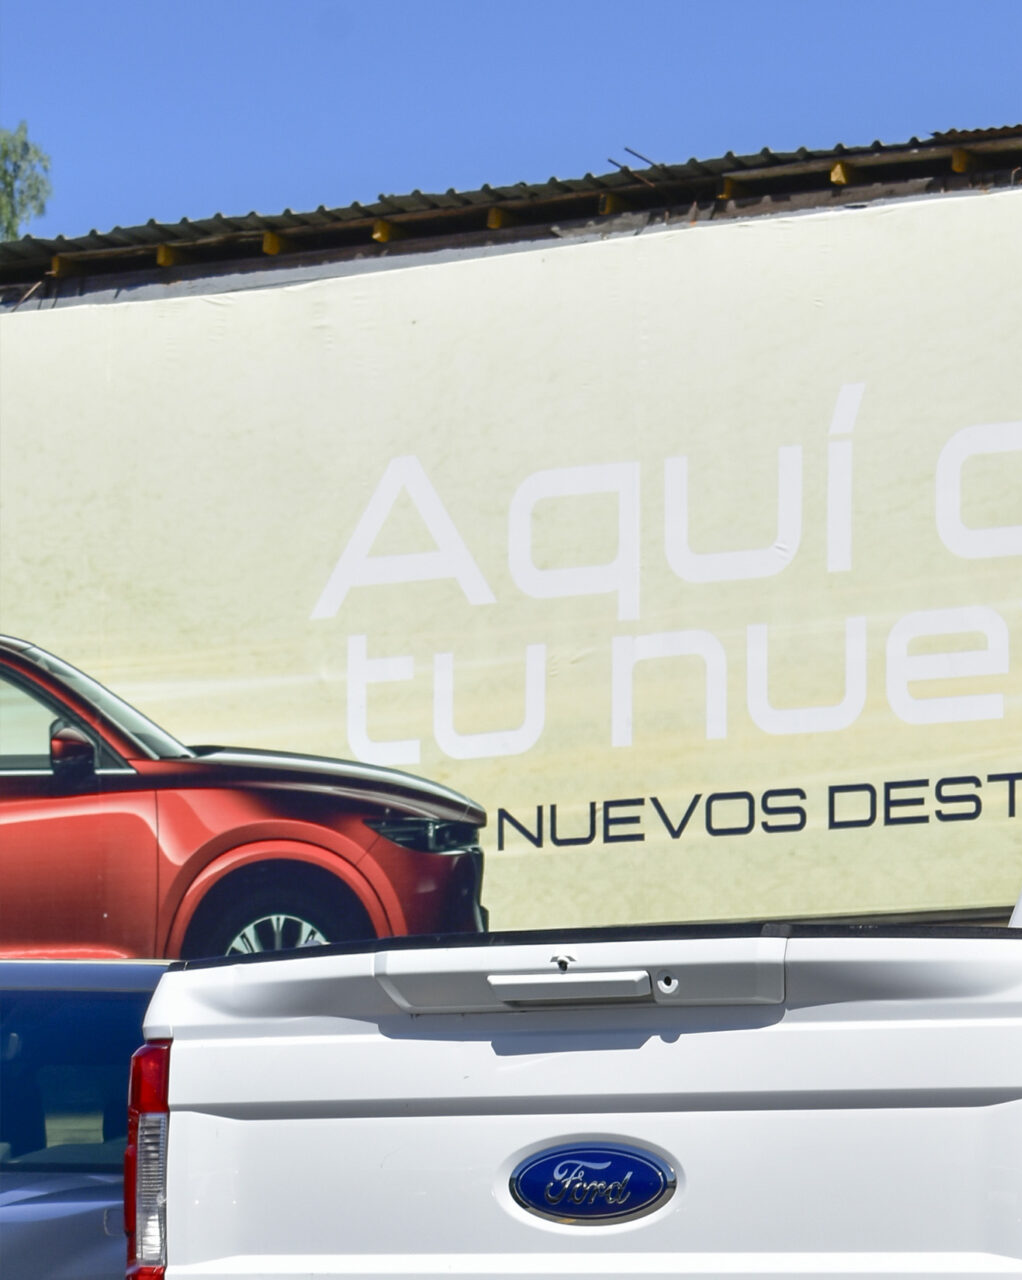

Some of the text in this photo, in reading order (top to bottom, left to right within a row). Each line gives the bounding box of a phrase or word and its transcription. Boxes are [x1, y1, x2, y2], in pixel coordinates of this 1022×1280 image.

[310, 383, 865, 620] Aquí
[347, 634, 547, 765] tu
[498, 787, 807, 851] NUEVOS
[545, 1159, 634, 1206] Ford
